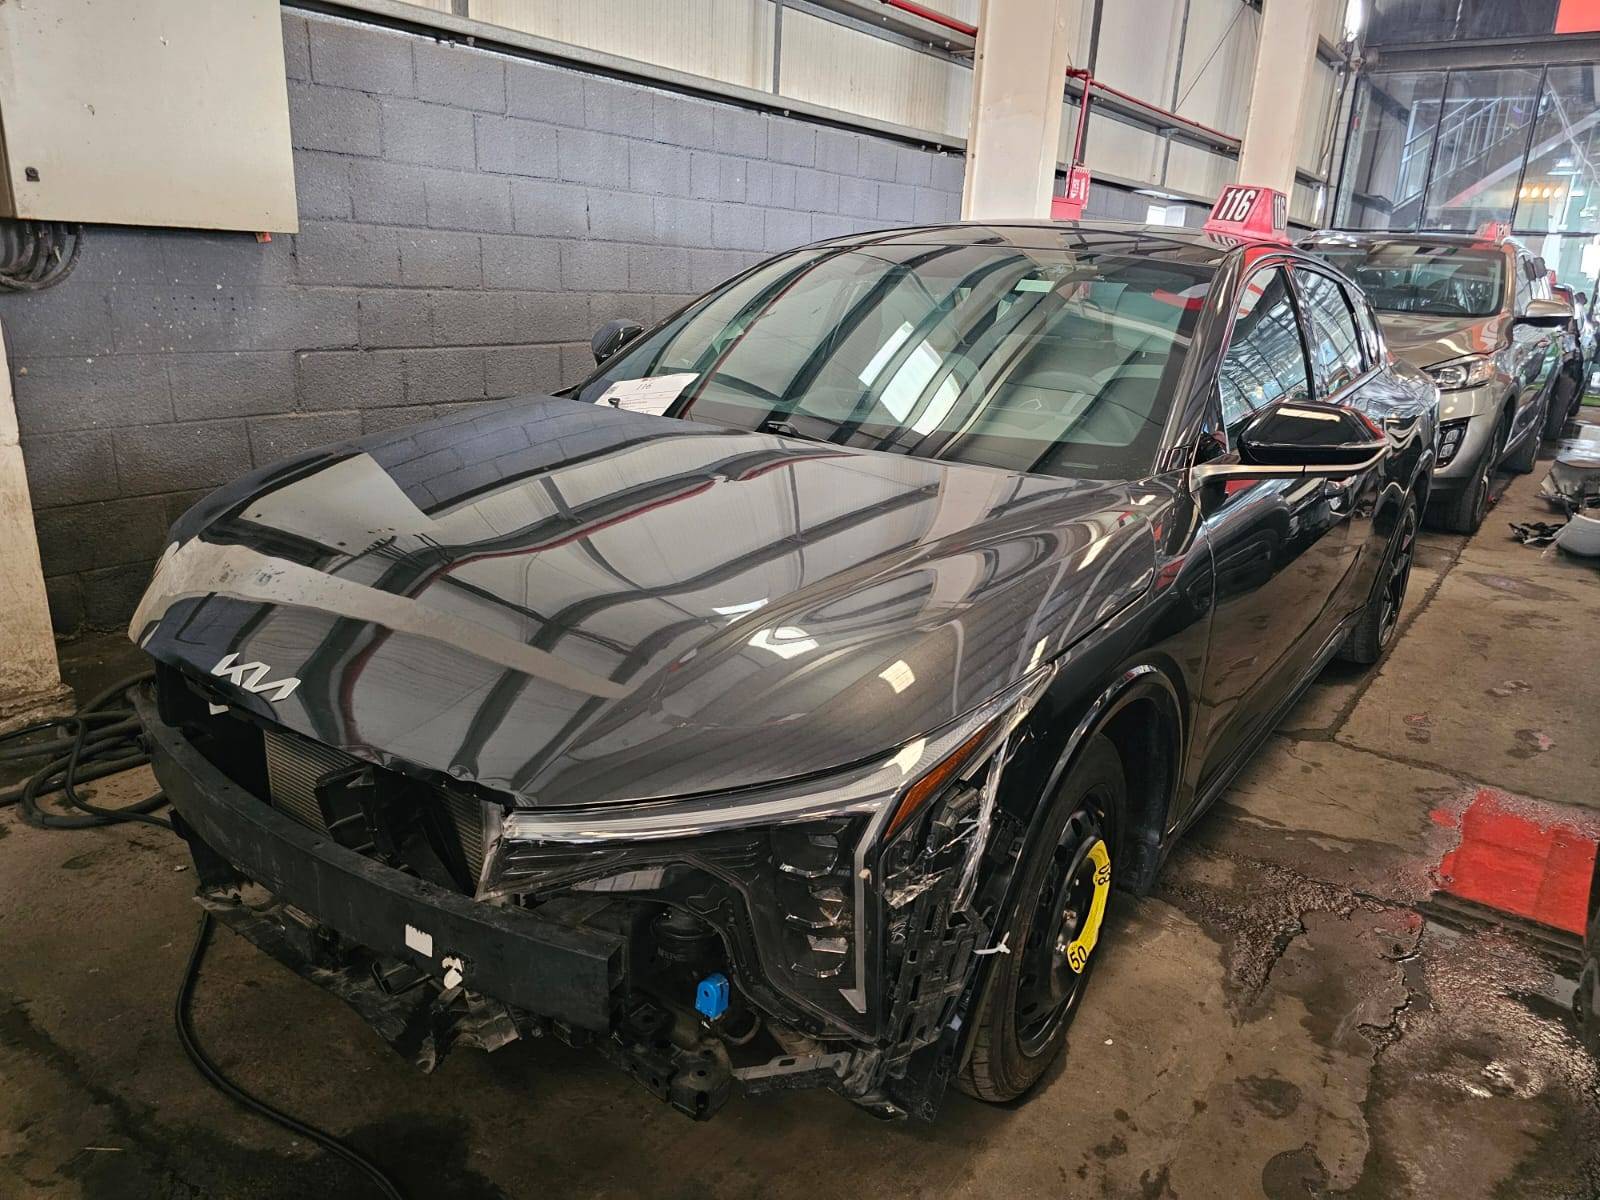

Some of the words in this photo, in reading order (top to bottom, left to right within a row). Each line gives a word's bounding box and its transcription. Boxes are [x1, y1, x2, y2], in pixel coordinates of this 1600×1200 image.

[1217, 188, 1256, 221] 116
[1274, 195, 1286, 229] 116
[211, 653, 301, 702] KIA
[1070, 946, 1087, 970] 50
